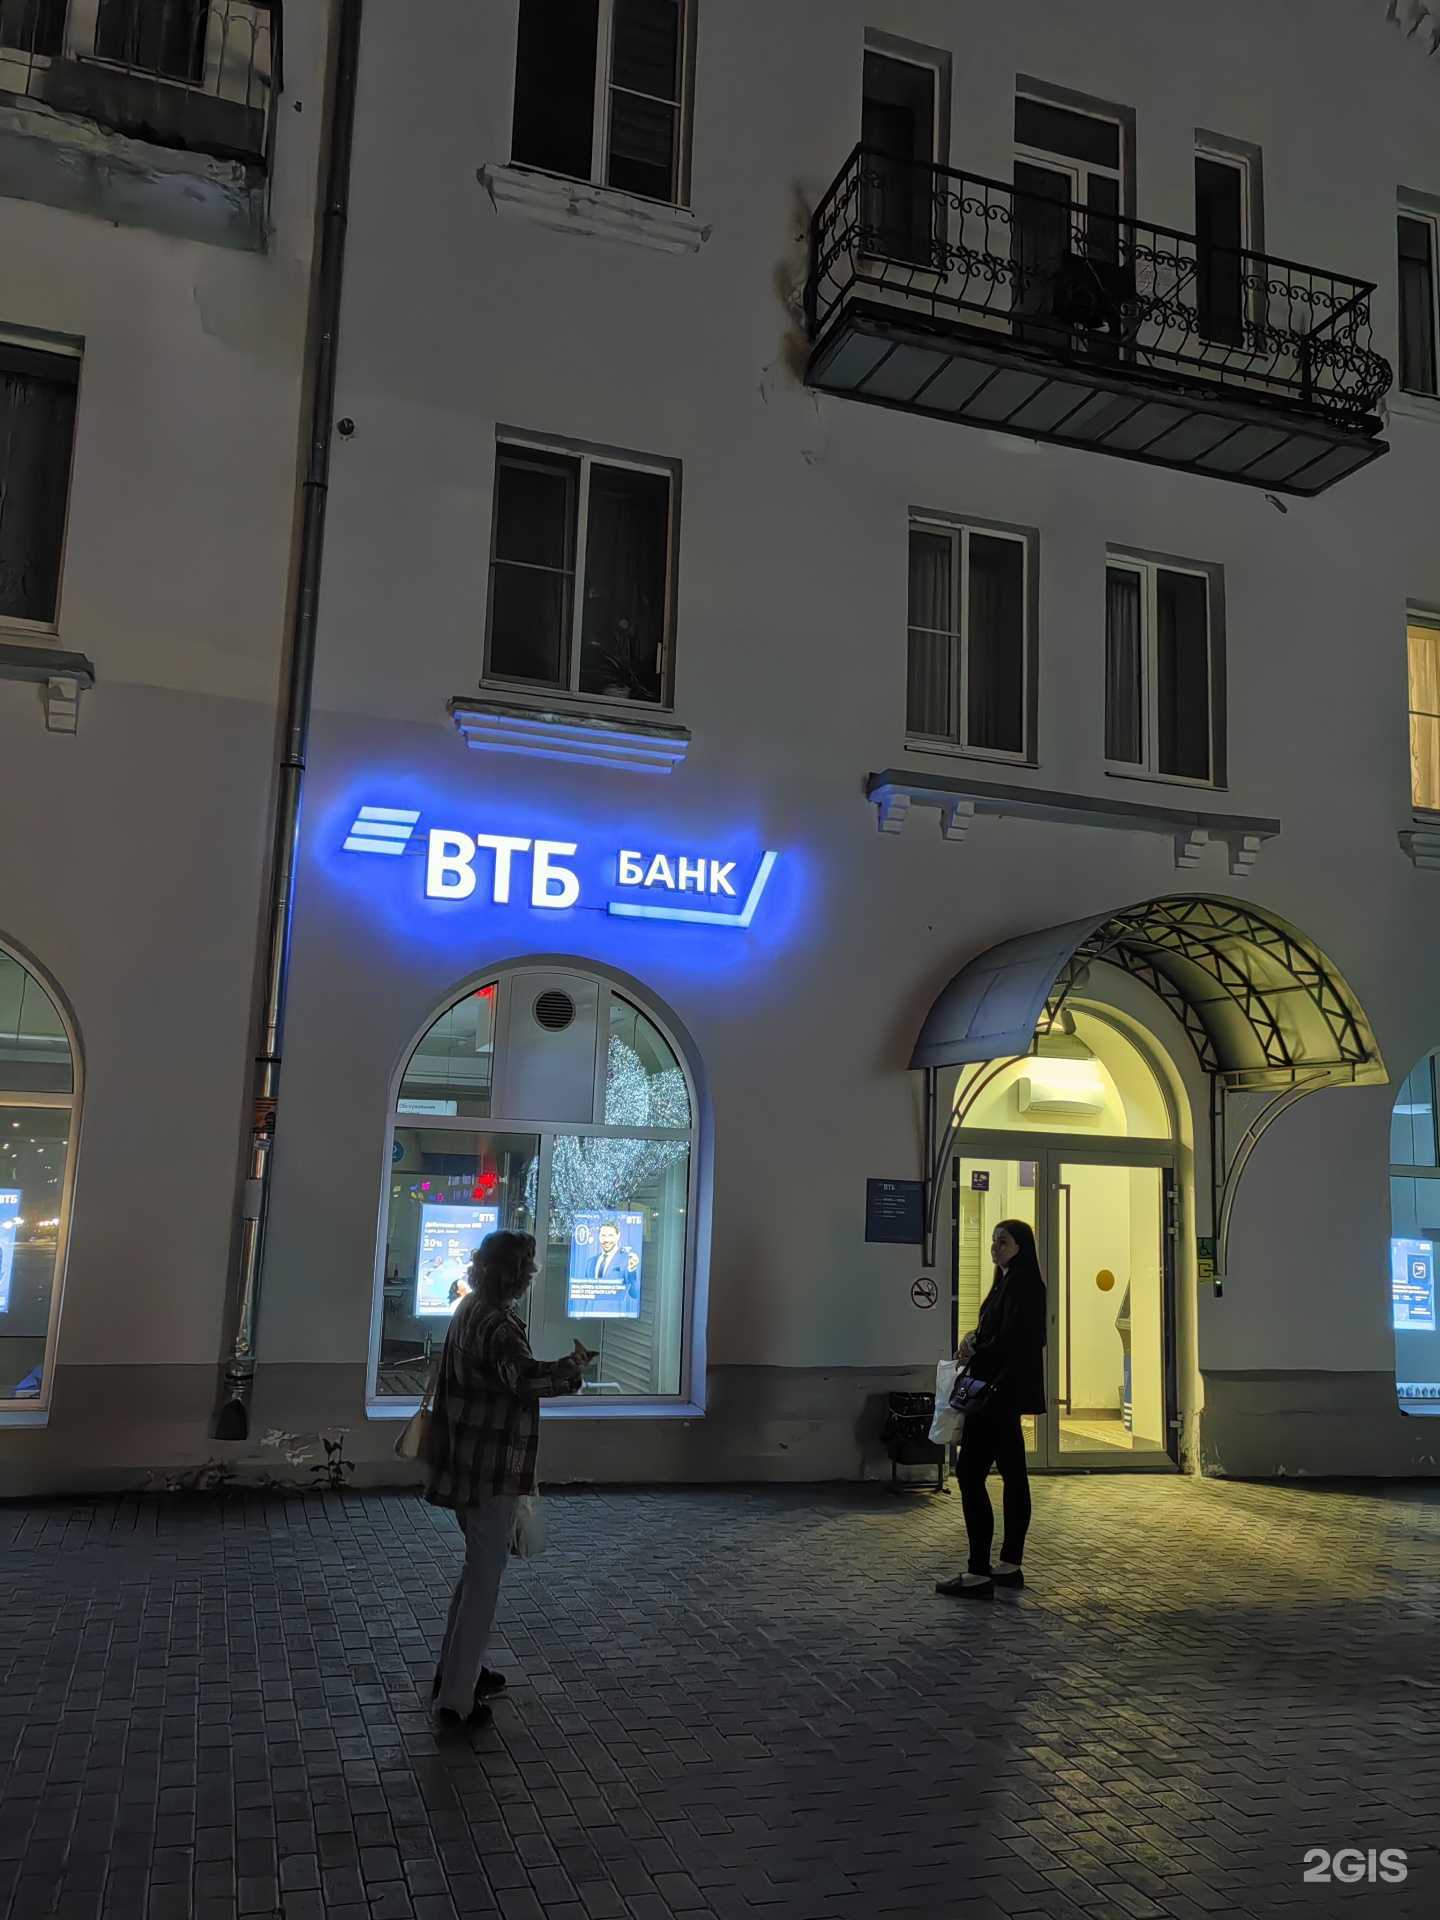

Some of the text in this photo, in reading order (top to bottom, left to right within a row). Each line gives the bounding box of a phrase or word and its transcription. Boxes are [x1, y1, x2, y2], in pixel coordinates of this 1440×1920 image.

[426, 828, 737, 909] ВТБ БАНК
[479, 1212, 496, 1223] ВТБ
[626, 1215, 642, 1225] ВТБ
